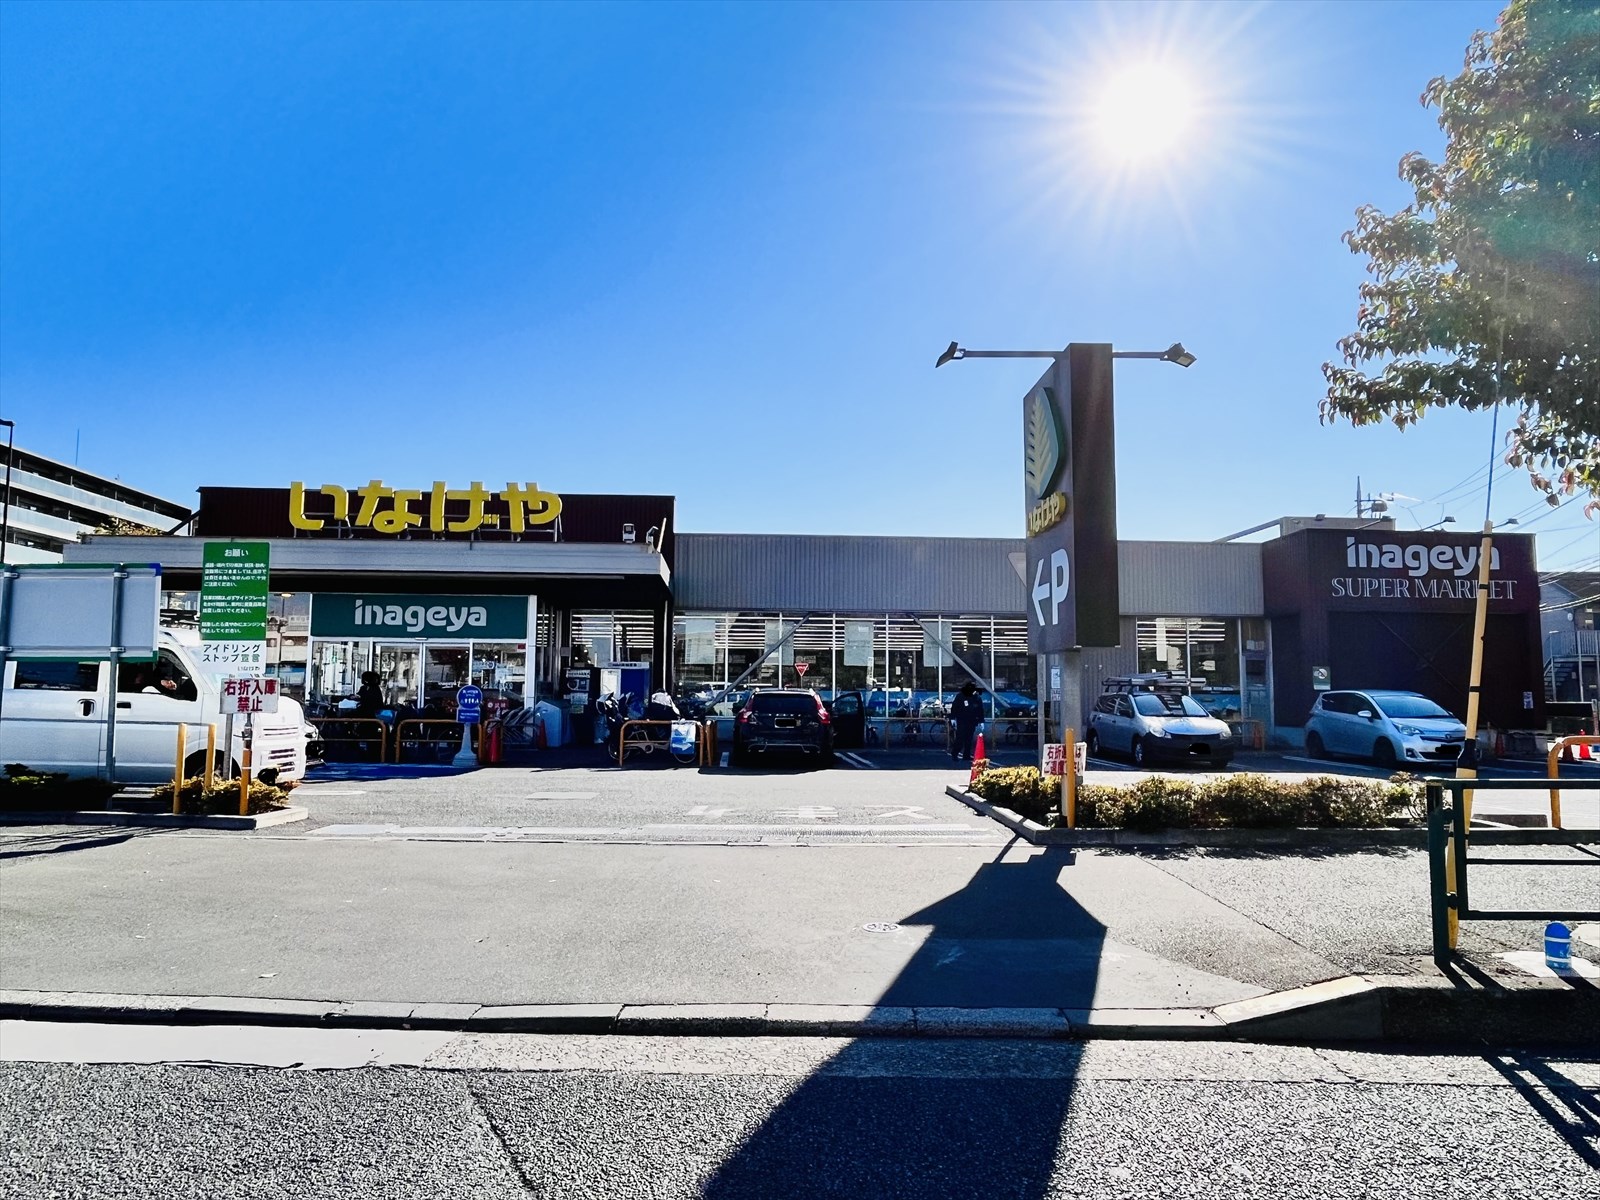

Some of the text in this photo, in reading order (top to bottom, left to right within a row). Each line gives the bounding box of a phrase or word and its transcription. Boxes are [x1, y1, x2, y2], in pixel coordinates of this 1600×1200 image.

[289, 480, 562, 534] いなげや
[224, 548, 249, 557] お願い
[1347, 537, 1500, 577] inageya
[1051, 548, 1070, 626] P
[1331, 577, 1411, 599] SUPER
[354, 599, 487, 633] inageya
[202, 653, 261, 663] ストップ宣言
[203, 644, 261, 653] アイドリング
[224, 679, 277, 696] 右折入庫
[237, 696, 263, 712] 禁止
